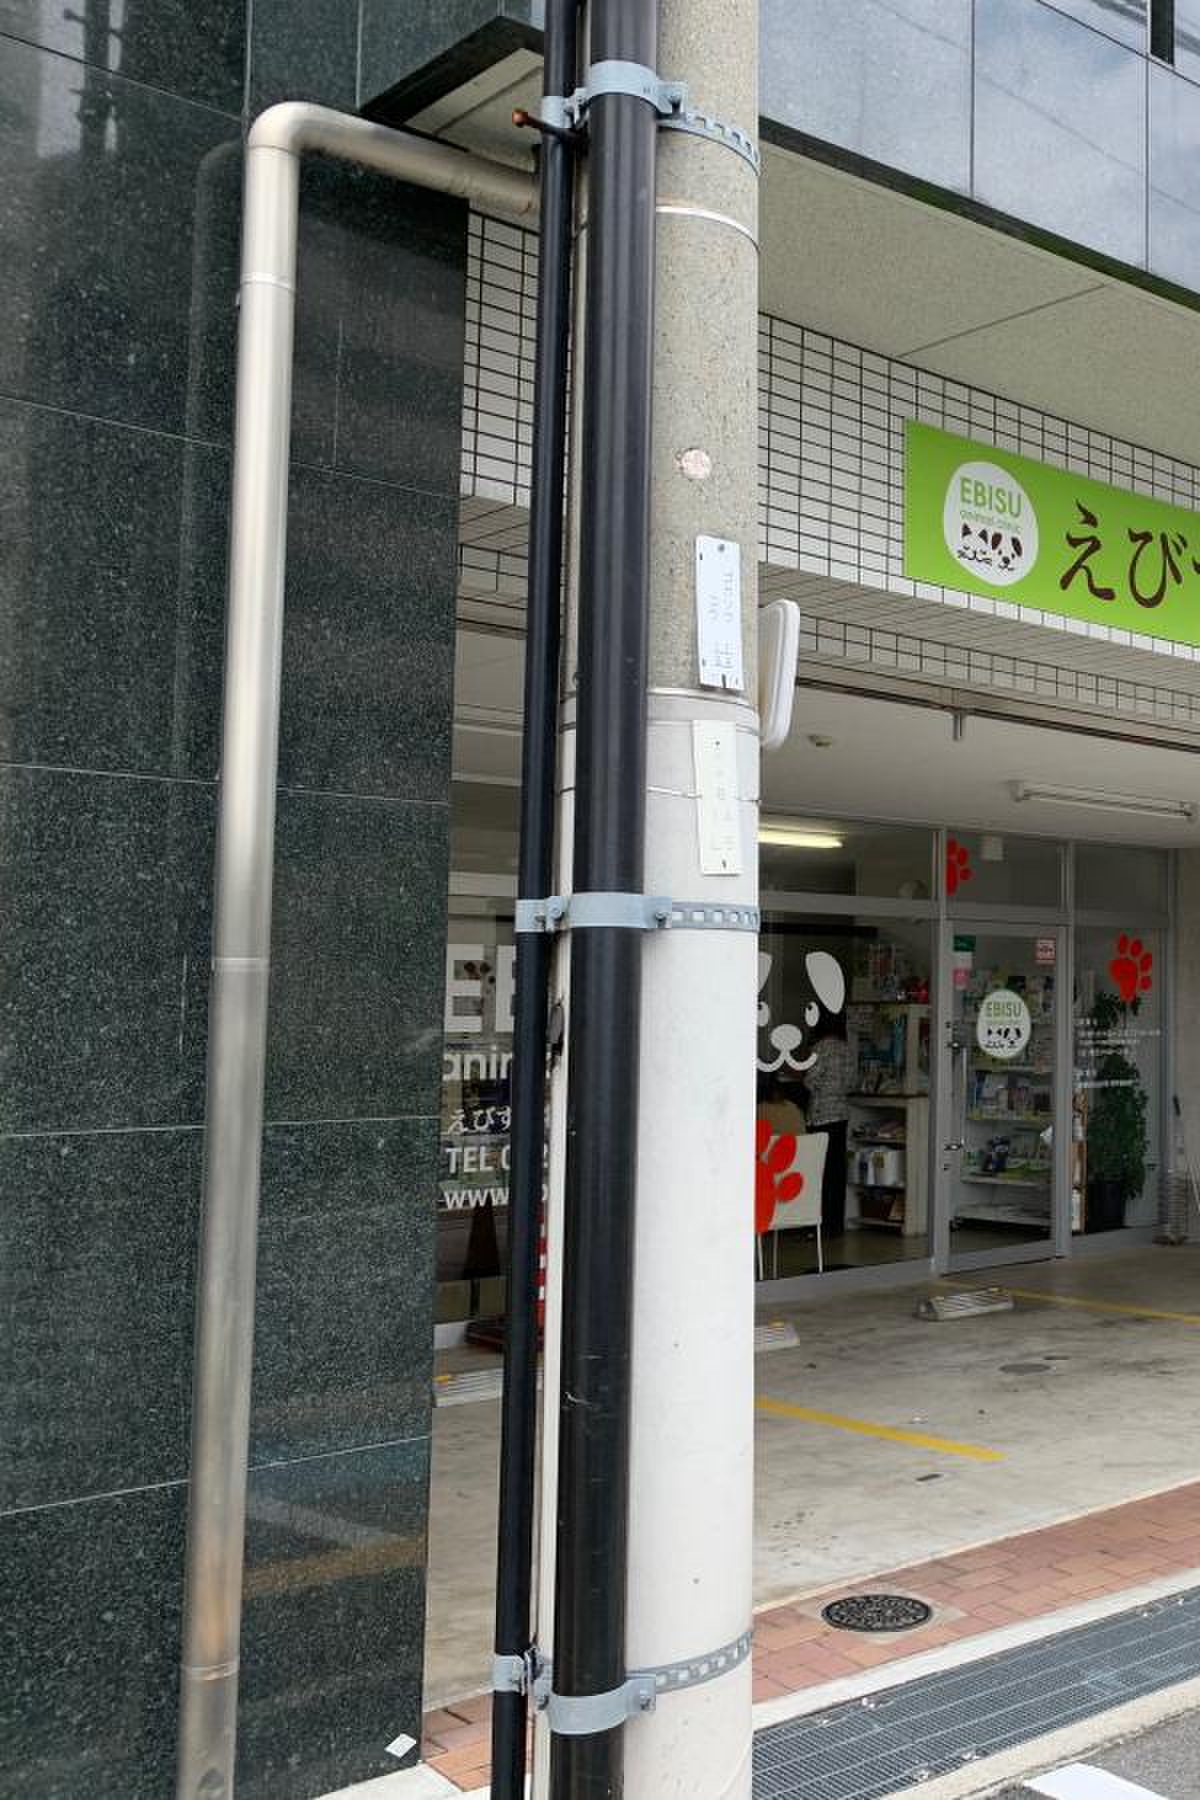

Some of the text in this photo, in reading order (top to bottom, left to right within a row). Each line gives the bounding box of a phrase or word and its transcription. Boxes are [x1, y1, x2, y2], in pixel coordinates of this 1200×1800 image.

[960, 477, 1022, 518] EBISU
[985, 1001, 1022, 1018] EBISU
[445, 1146, 494, 1174] TEL
